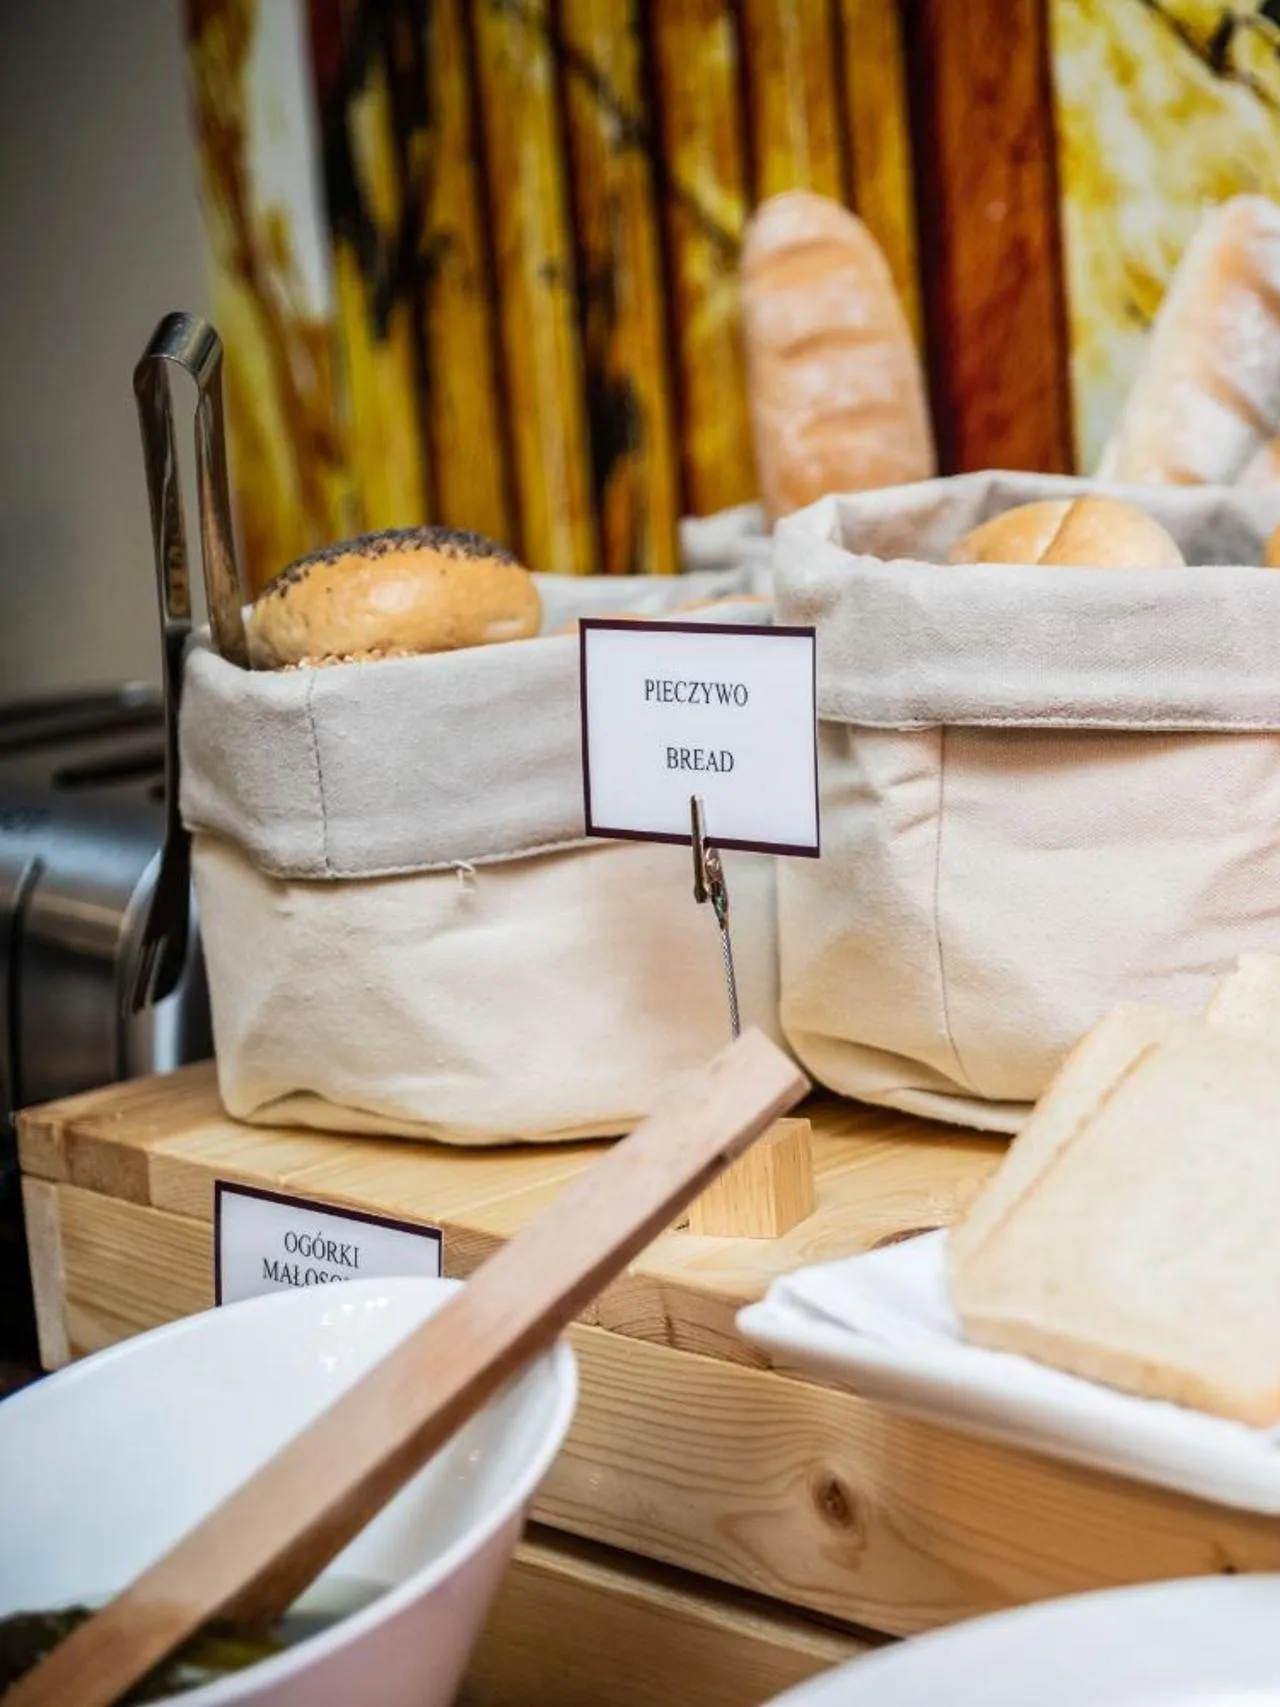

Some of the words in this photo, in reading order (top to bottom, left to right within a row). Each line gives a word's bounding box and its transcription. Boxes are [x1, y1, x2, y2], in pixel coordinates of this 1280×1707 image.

[644, 678, 749, 707] PIECZYWO
[666, 747, 735, 773] BREAD
[283, 1230, 360, 1268] OGÓRKI
[263, 1257, 351, 1287] MAŁOS
